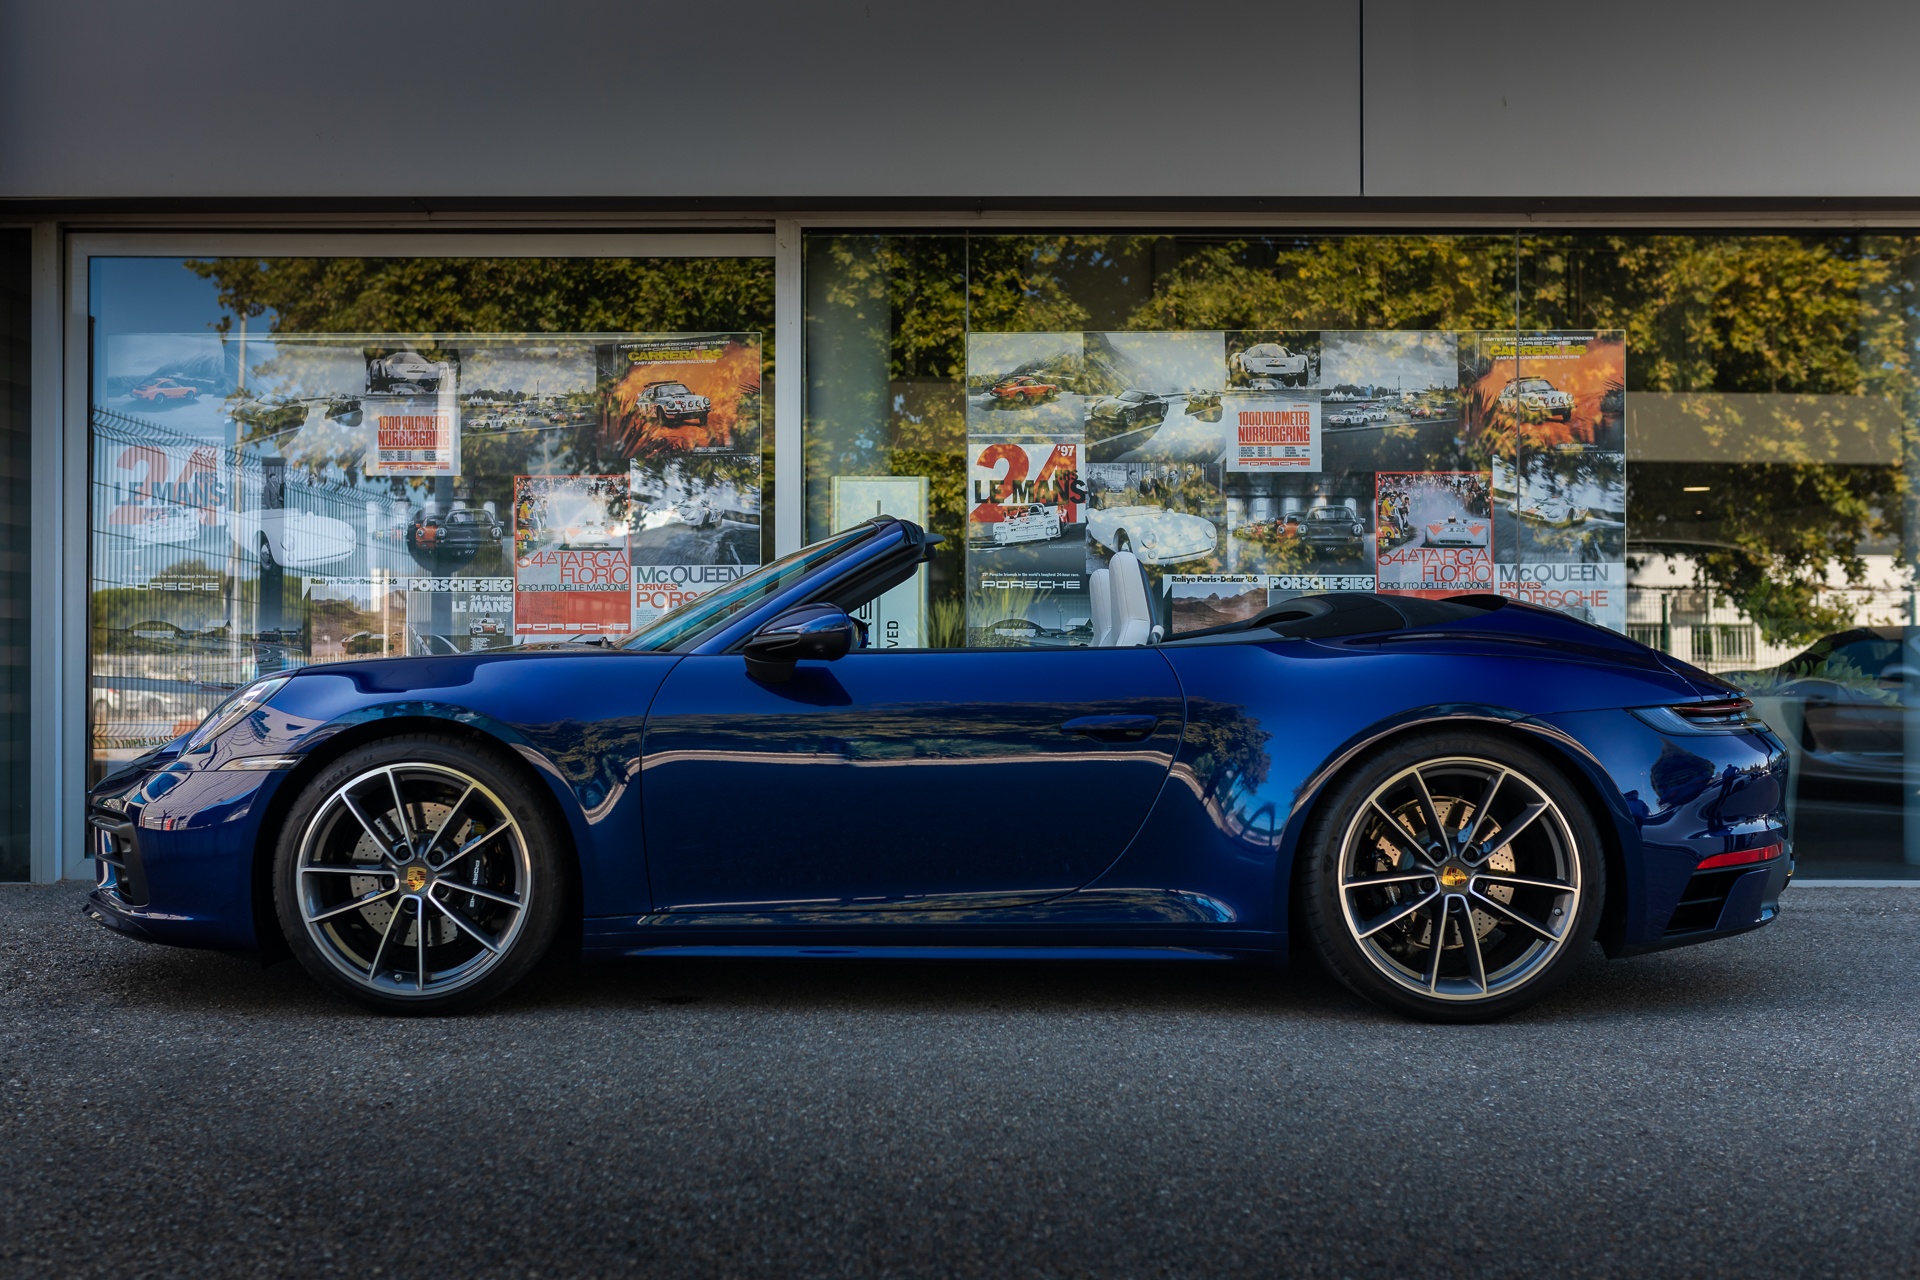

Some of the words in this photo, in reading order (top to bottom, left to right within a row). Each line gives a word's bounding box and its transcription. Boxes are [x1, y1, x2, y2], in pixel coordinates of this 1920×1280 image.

[628, 350, 699, 361] CARRERA
[701, 349, 724, 360] RS
[1490, 345, 1562, 356] CARRERA
[1565, 345, 1587, 355] RS
[378, 415, 400, 430] 1000
[402, 415, 449, 430] KILOMETER
[1238, 411, 1261, 426] 1000
[1262, 411, 1310, 426] KILOMETER
[1057, 446, 1075, 457] '97
[1054, 470, 1079, 481] HRS
[114, 481, 145, 506] LE
[151, 481, 227, 507] MANS
[974, 479, 1005, 504] LE
[1012, 479, 1086, 504] MANS
[555, 551, 629, 568] TARGA
[1416, 548, 1491, 566] TARGA
[559, 567, 629, 585] FLORIO
[636, 566, 744, 587] McQUEEN
[1171, 576, 1196, 584] Rallye
[1197, 575, 1245, 583] Paris-Dakar
[1246, 575, 1259, 583] '86
[1422, 565, 1492, 582] FLORIO
[1499, 564, 1609, 586] McQUEEN
[121, 582, 219, 591] PORSCHE
[310, 578, 335, 586] Rallye
[408, 579, 512, 592] PORSCHE-SIEG
[517, 584, 557, 592] CIRCUITO
[558, 584, 586, 592] DELLE
[586, 584, 629, 592] MADONIE
[982, 580, 1080, 589] PORSCHE
[1269, 577, 1375, 590] PORSCHE-SIEG
[1378, 582, 1419, 590] CIRCUITO
[1420, 582, 1448, 590] DELLE
[1448, 582, 1492, 590] MADONIE
[482, 594, 513, 602] Stunden
[636, 591, 710, 609] PORS
[451, 601, 467, 613] LE
[469, 601, 512, 613] MANS
[517, 623, 629, 631] PORSCHE
[120, 737, 147, 749] TRIPLE
[149, 735, 177, 746] CLASS
[319, 764, 353, 793] EAGLE
[469, 860, 481, 908] PORSHE
